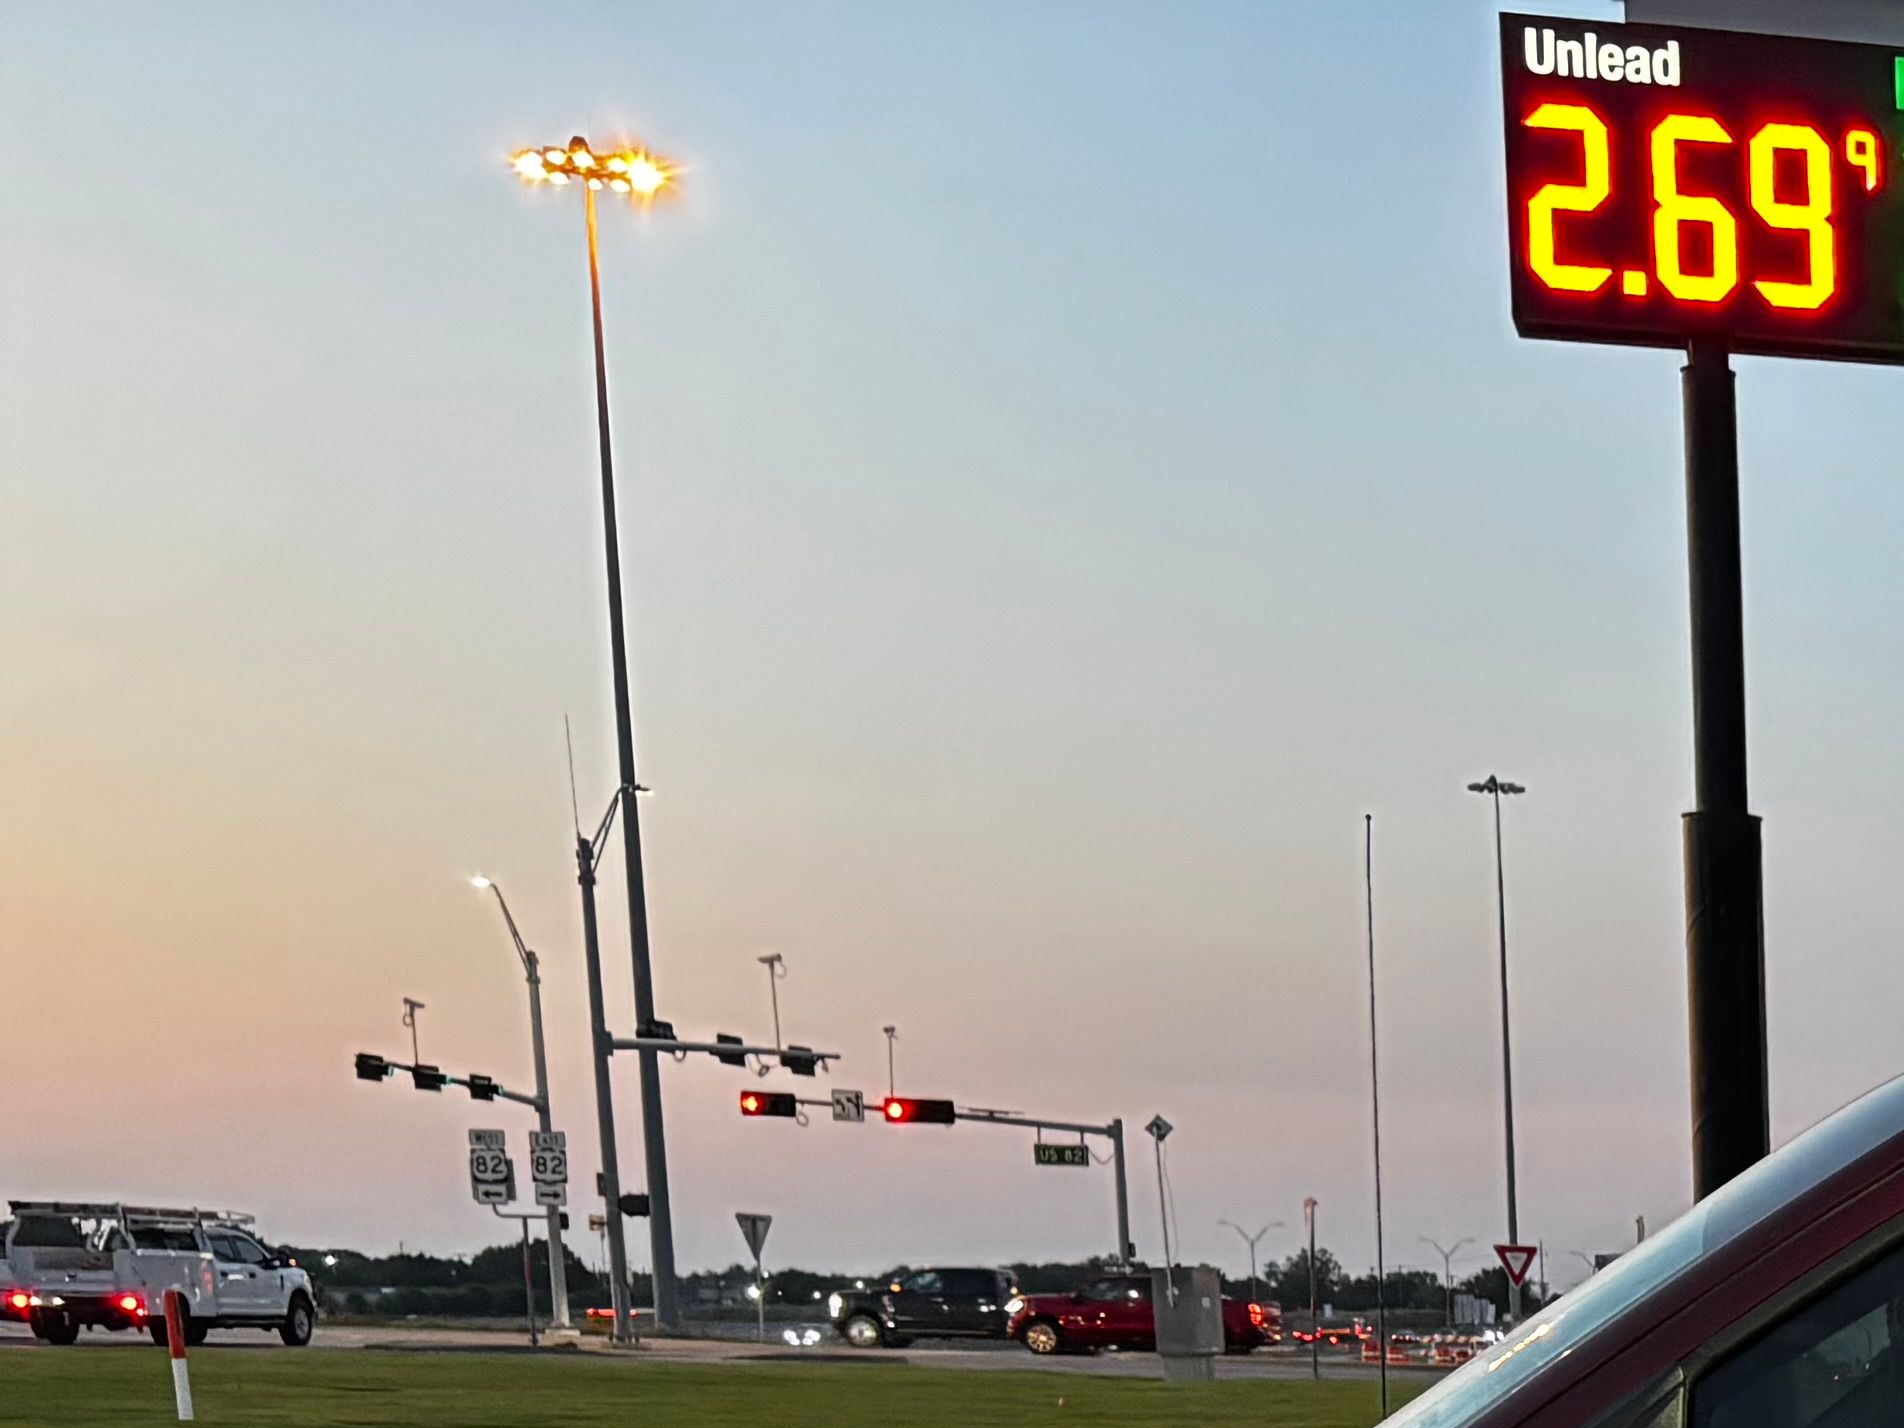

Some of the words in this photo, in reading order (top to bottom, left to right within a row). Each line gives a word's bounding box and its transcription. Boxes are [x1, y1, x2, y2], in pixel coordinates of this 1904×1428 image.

[1524, 28, 1681, 88] Unlead
[1040, 1147, 1058, 1162] US
[476, 1155, 504, 1174] 82
[535, 1155, 564, 1175] 82
